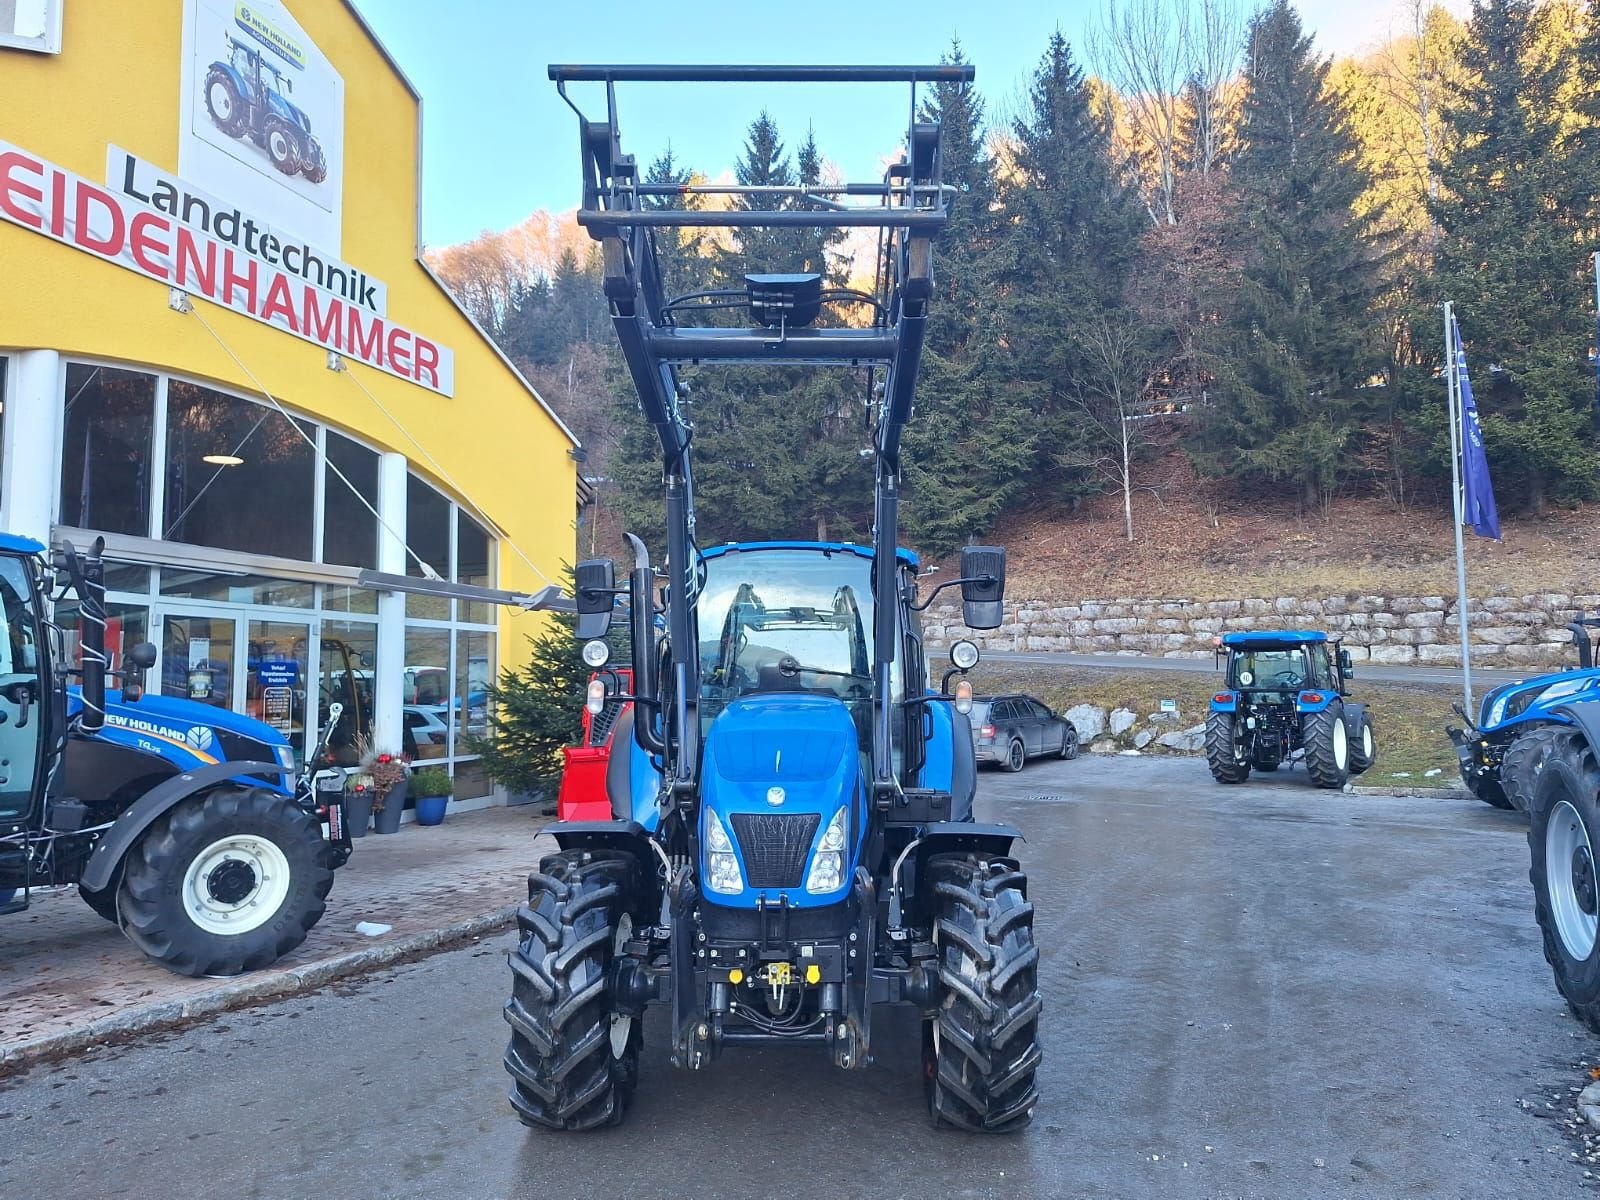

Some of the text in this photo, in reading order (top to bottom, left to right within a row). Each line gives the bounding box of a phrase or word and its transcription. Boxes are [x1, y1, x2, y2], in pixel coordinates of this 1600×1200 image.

[252, 17, 302, 58] NEW HOLLAND
[123, 154, 377, 312] Landtechnik
[129, 718, 186, 743] HOLLAND
